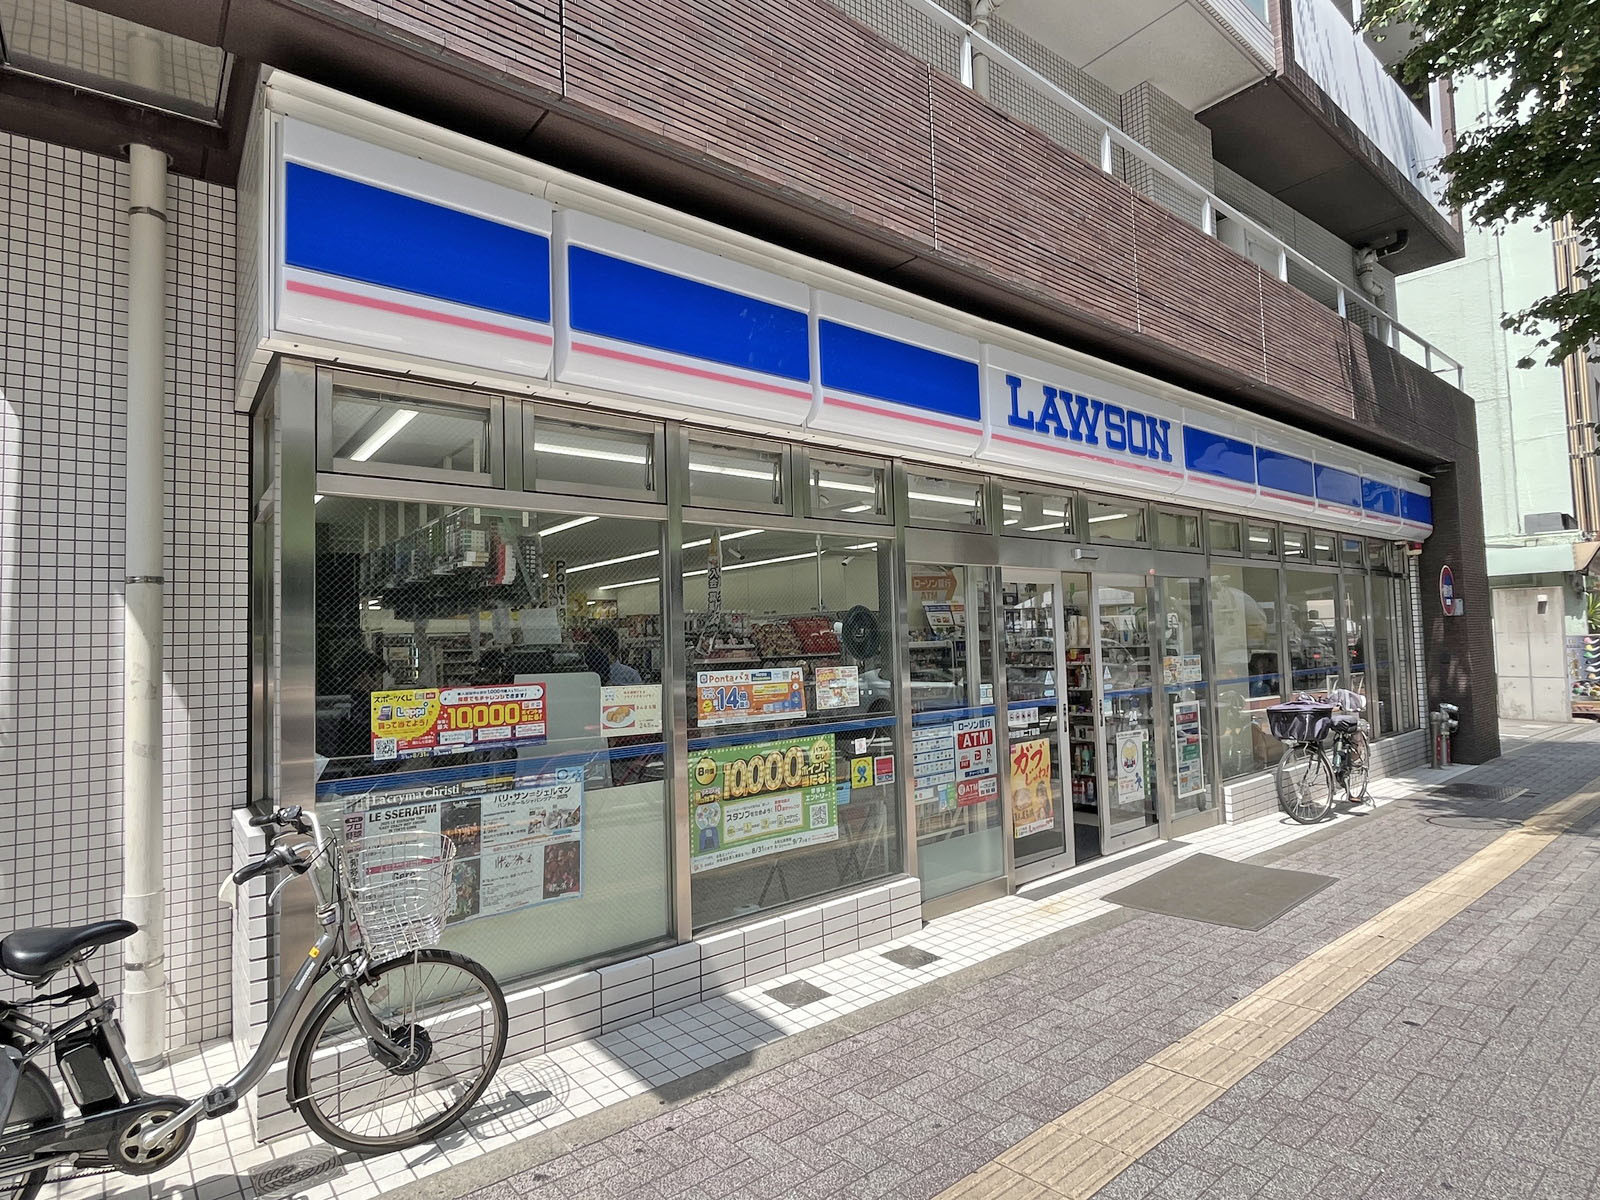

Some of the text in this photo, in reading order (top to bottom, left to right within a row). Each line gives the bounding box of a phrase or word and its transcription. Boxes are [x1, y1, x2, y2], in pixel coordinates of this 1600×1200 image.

[1005, 374, 1173, 463] LAWSON
[374, 694, 413, 703] スポーツくじ
[447, 703, 520, 729] 10,000
[963, 731, 989, 748] ATM
[723, 746, 805, 800] 10,000
[423, 784, 460, 797] Christi
[369, 812, 382, 823] LE
[385, 804, 437, 820] SSERAFIM
[346, 823, 362, 831] プロ
